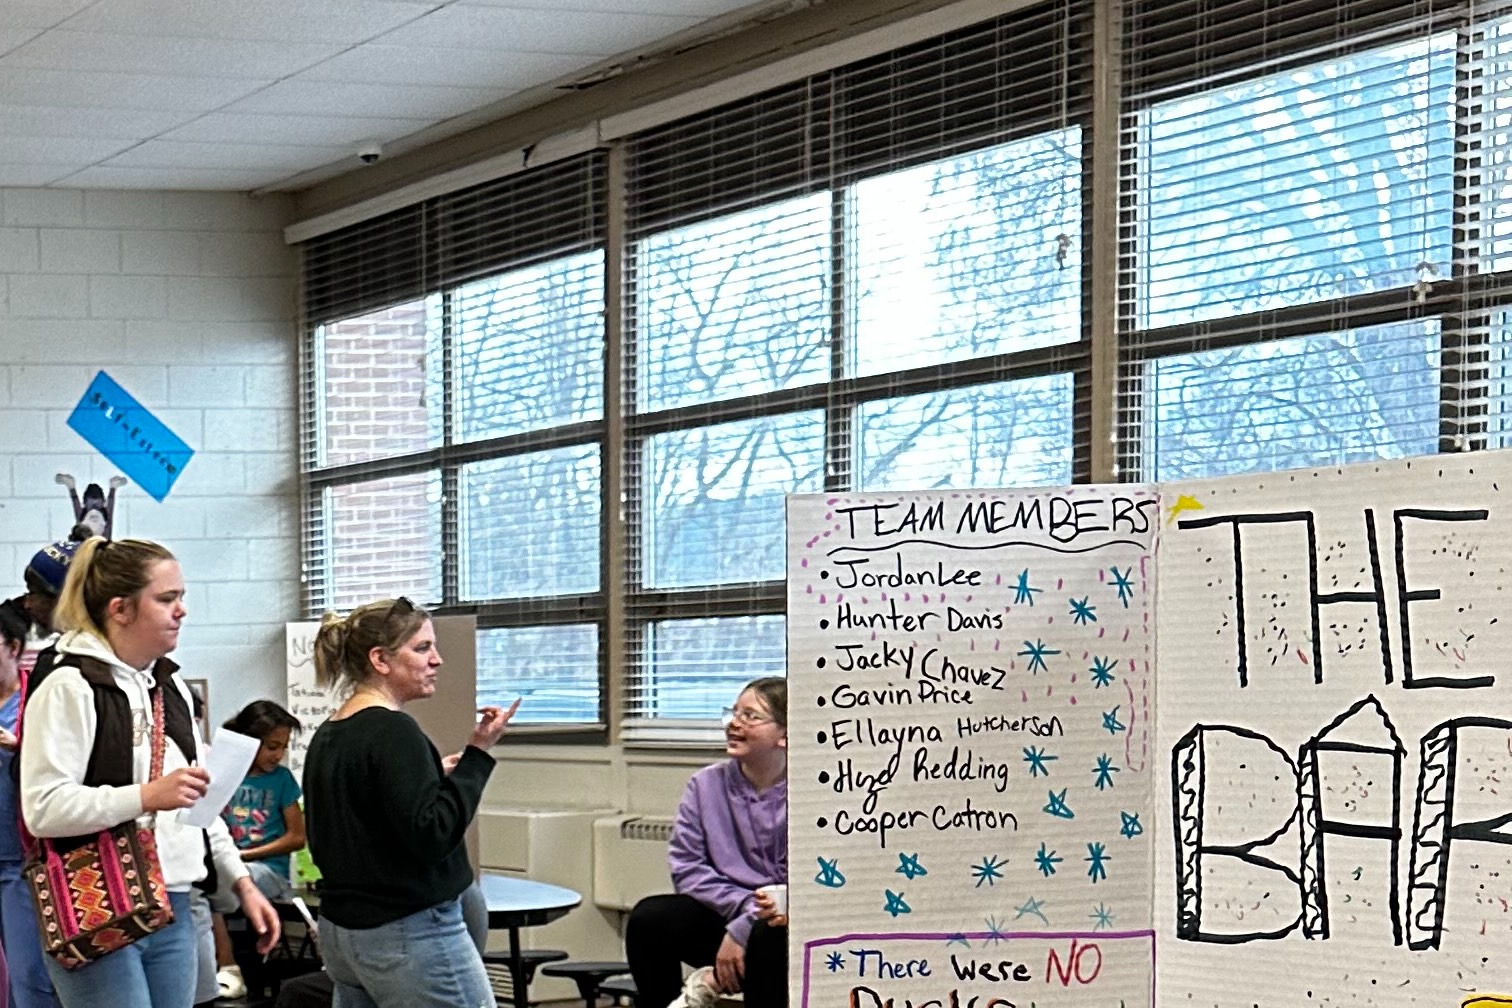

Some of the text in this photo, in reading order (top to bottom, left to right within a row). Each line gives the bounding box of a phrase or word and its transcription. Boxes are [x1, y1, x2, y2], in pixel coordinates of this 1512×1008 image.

[835, 498, 1158, 542] TEAM MEMBERS
[837, 598, 1003, 632] Hunter Davis
[1178, 508, 1496, 689] THE
[835, 641, 914, 680] Jacky
[832, 680, 974, 709] Gavin Price
[832, 718, 943, 753] Ellayna
[913, 746, 1009, 793] Redding
[835, 798, 1018, 849] Cooper Catron
[849, 950, 931, 979] There
[1046, 939, 1102, 986] NO
